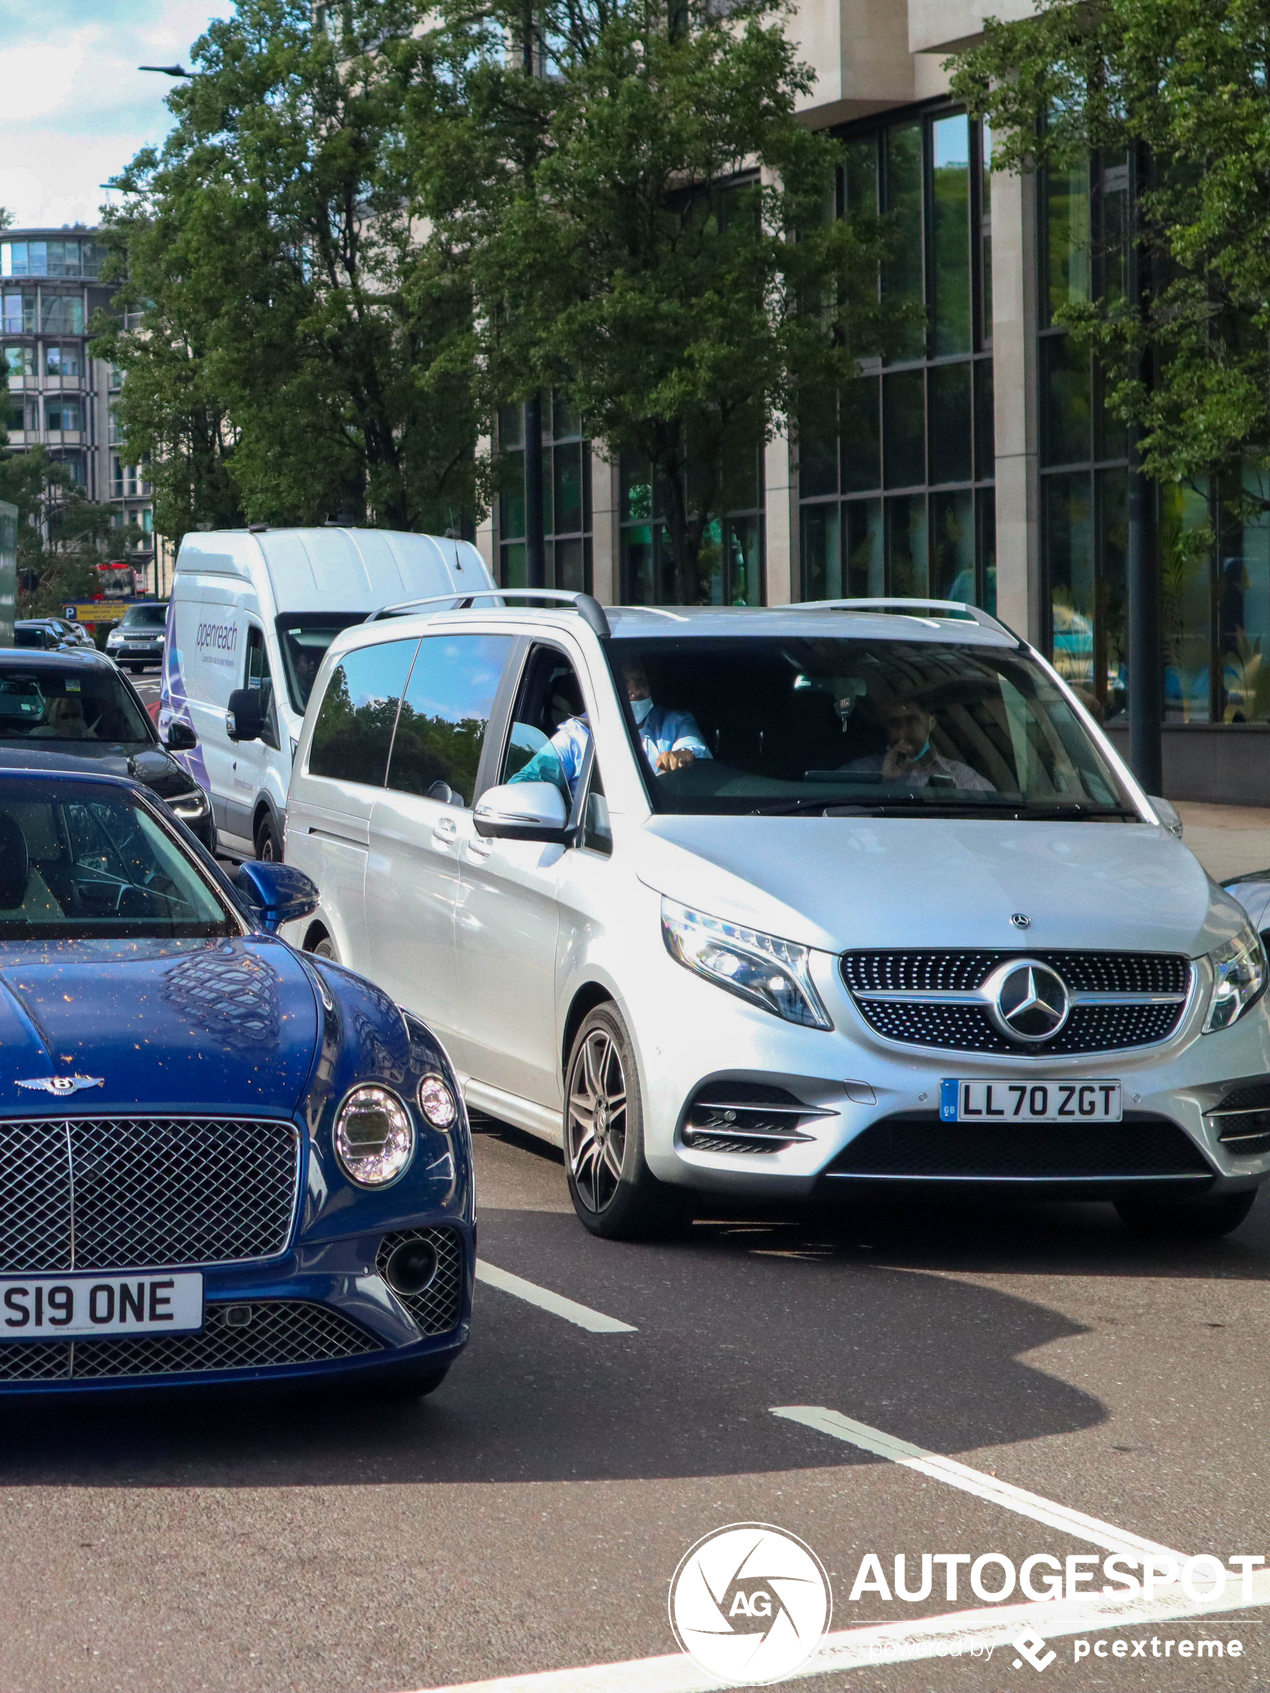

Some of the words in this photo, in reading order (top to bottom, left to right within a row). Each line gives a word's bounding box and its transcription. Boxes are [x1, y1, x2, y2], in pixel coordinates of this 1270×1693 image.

[65, 607, 75, 619] P
[197, 621, 238, 652] openreach
[944, 1106, 956, 1115] GB
[964, 1085, 1048, 1116] LL70
[1058, 1086, 1116, 1116] ZGT
[89, 1280, 175, 1324] ONE
